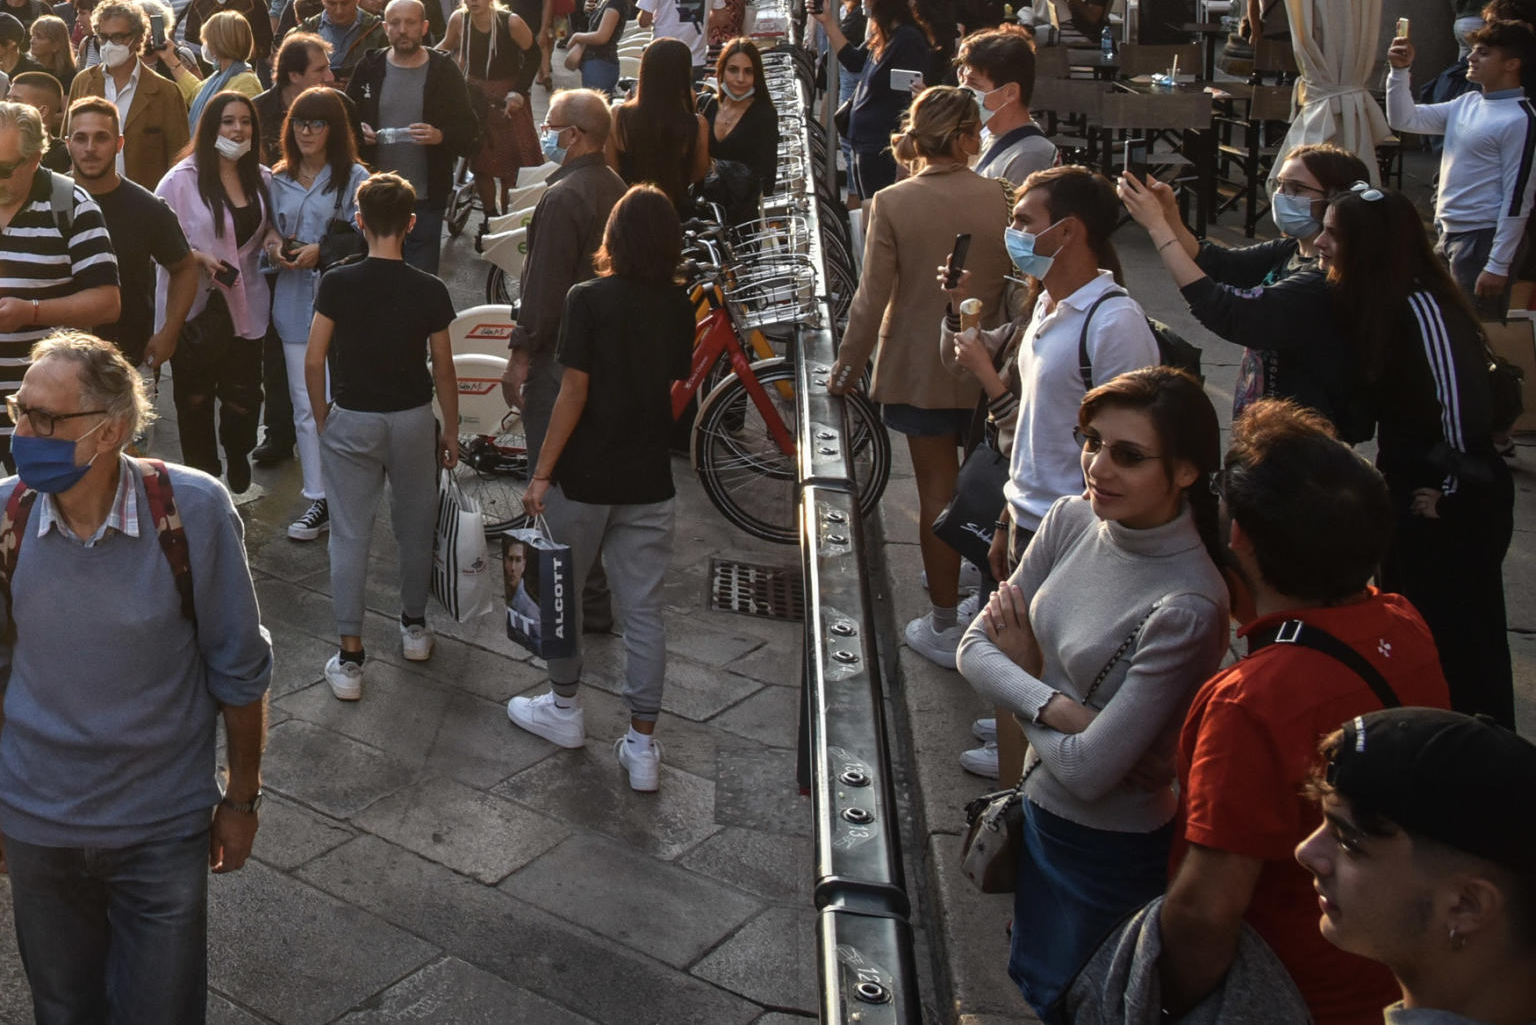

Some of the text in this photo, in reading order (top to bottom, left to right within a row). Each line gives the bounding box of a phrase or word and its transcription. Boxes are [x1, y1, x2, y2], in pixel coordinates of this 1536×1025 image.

[553, 557, 564, 640] ALCOTT
[848, 825, 869, 838] 13
[856, 967, 881, 983] 12
